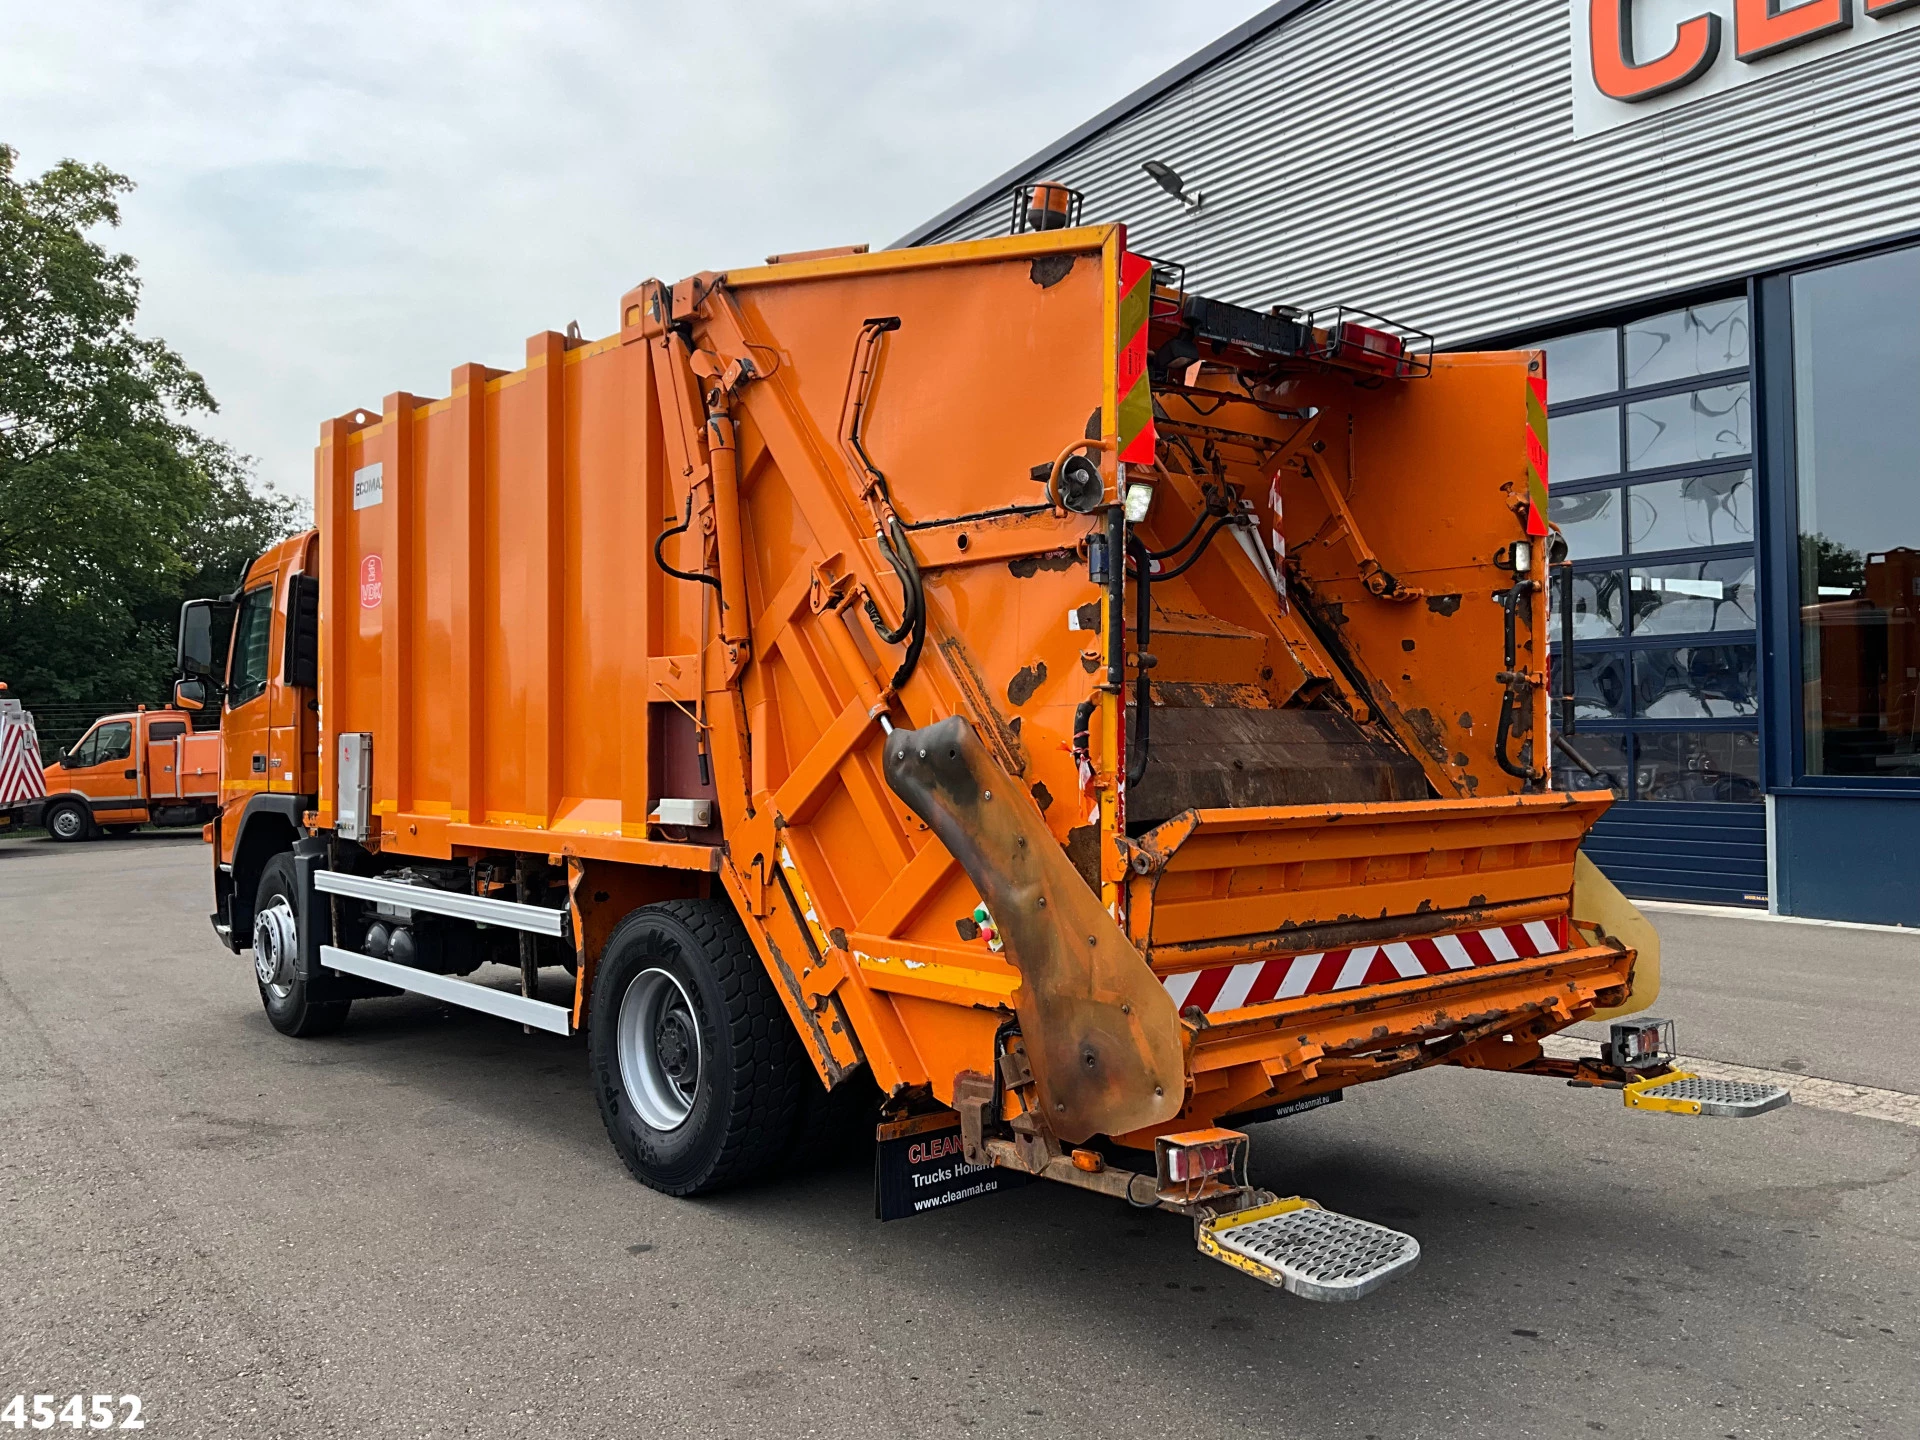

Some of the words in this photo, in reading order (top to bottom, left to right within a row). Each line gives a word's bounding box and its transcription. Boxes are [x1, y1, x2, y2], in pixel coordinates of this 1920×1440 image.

[1276, 1095, 1330, 1116] www.cleanmat.eu
[912, 1168, 952, 1188] Trucks
[913, 1180, 998, 1211] www.cleanmat.eu
